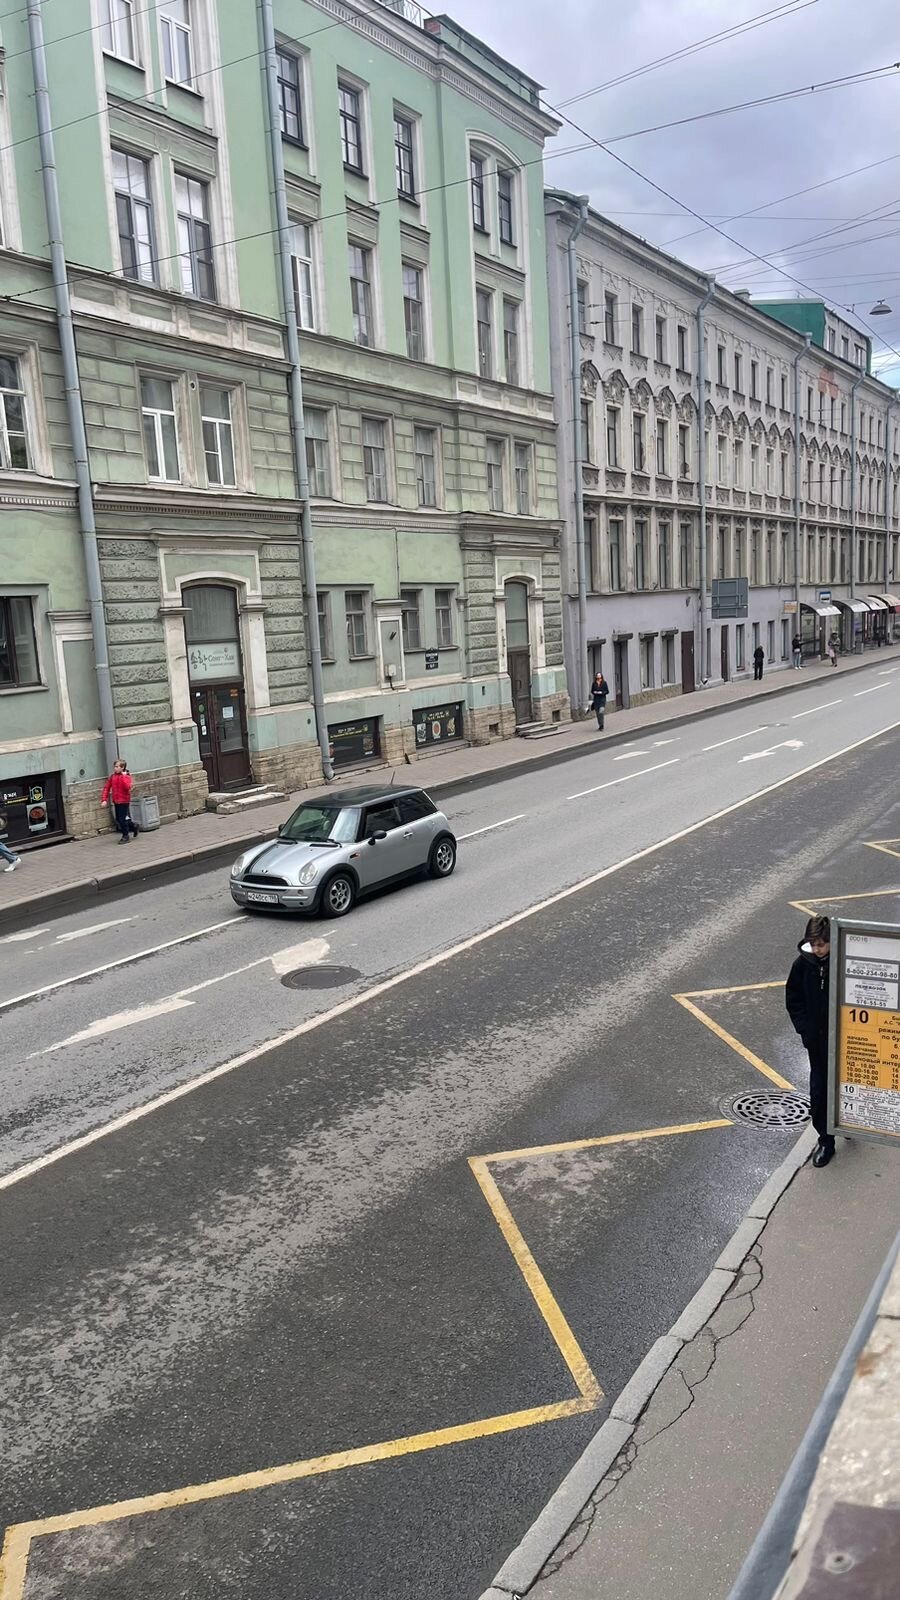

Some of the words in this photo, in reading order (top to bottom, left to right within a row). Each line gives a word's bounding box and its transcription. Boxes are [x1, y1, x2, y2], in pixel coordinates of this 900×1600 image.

[849, 1009, 869, 1024] 10
[846, 1055, 881, 1065] плановый
[844, 1085, 854, 1094] 10
[843, 1101, 853, 1111] 71
